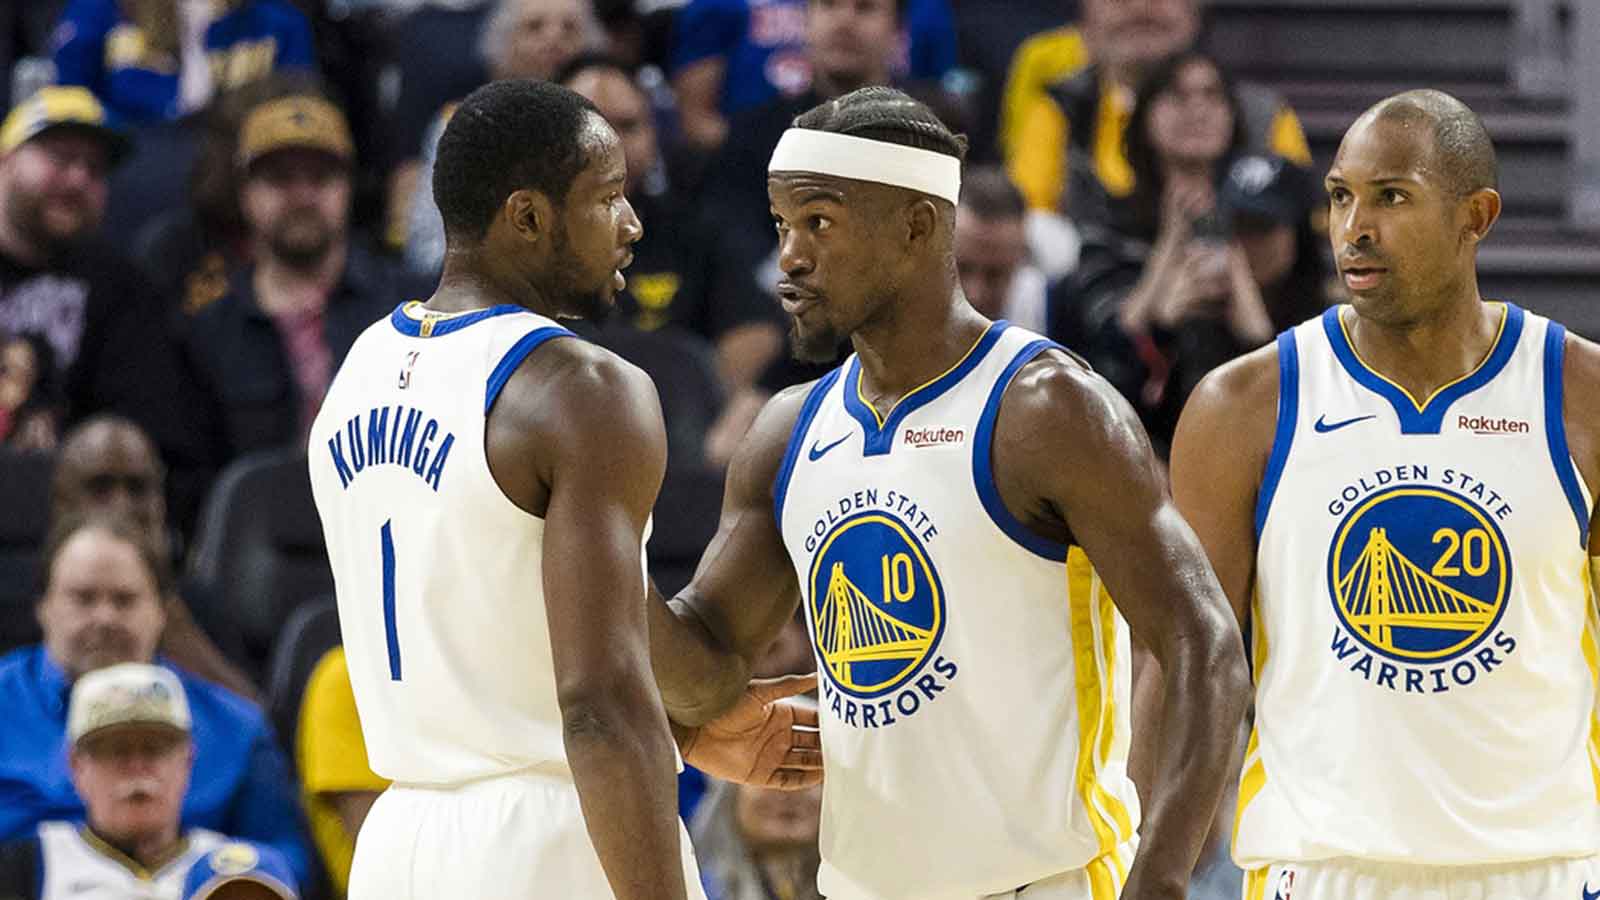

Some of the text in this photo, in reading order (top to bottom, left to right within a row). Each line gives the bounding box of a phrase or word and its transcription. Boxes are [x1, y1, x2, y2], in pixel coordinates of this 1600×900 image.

[328, 405, 455, 492] KUMINGA
[904, 428, 964, 448] Rakuten
[1458, 415, 1530, 434] Rakuten
[805, 489, 939, 553] GOLDEN STATE
[1328, 465, 1513, 521] GOLDEN STATE
[882, 553, 916, 603] 10
[1431, 528, 1491, 577] 20
[380, 518, 403, 681] 1
[1330, 625, 1517, 694] WARRIORS
